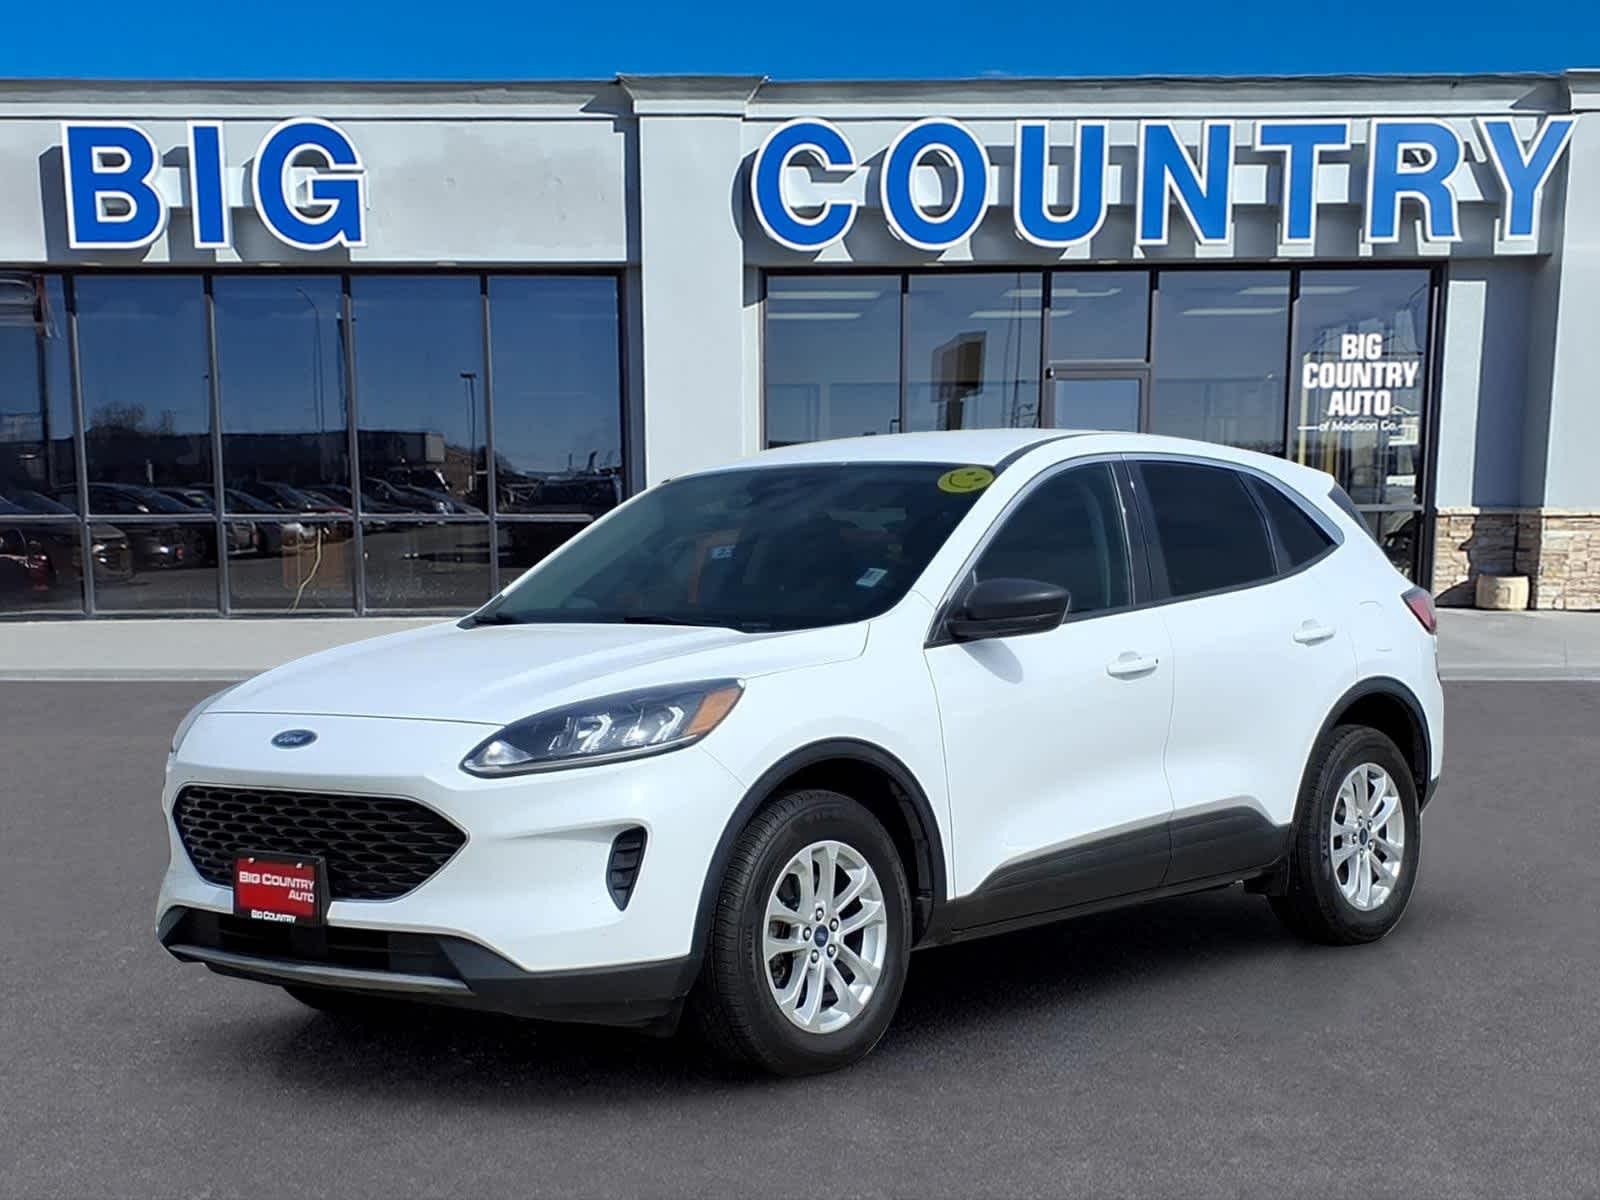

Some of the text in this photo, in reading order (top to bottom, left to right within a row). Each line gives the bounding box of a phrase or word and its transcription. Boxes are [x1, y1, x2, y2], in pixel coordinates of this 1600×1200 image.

[61, 115, 1577, 251] BIG COUNTRY
[1341, 333, 1383, 360] BIG
[1303, 361, 1419, 389] COUNTRY
[1327, 390, 1391, 417] AUTO
[1331, 420, 1378, 431] Madison
[239, 871, 315, 891] BIG COUNTRY
[288, 889, 315, 903] AUTO
